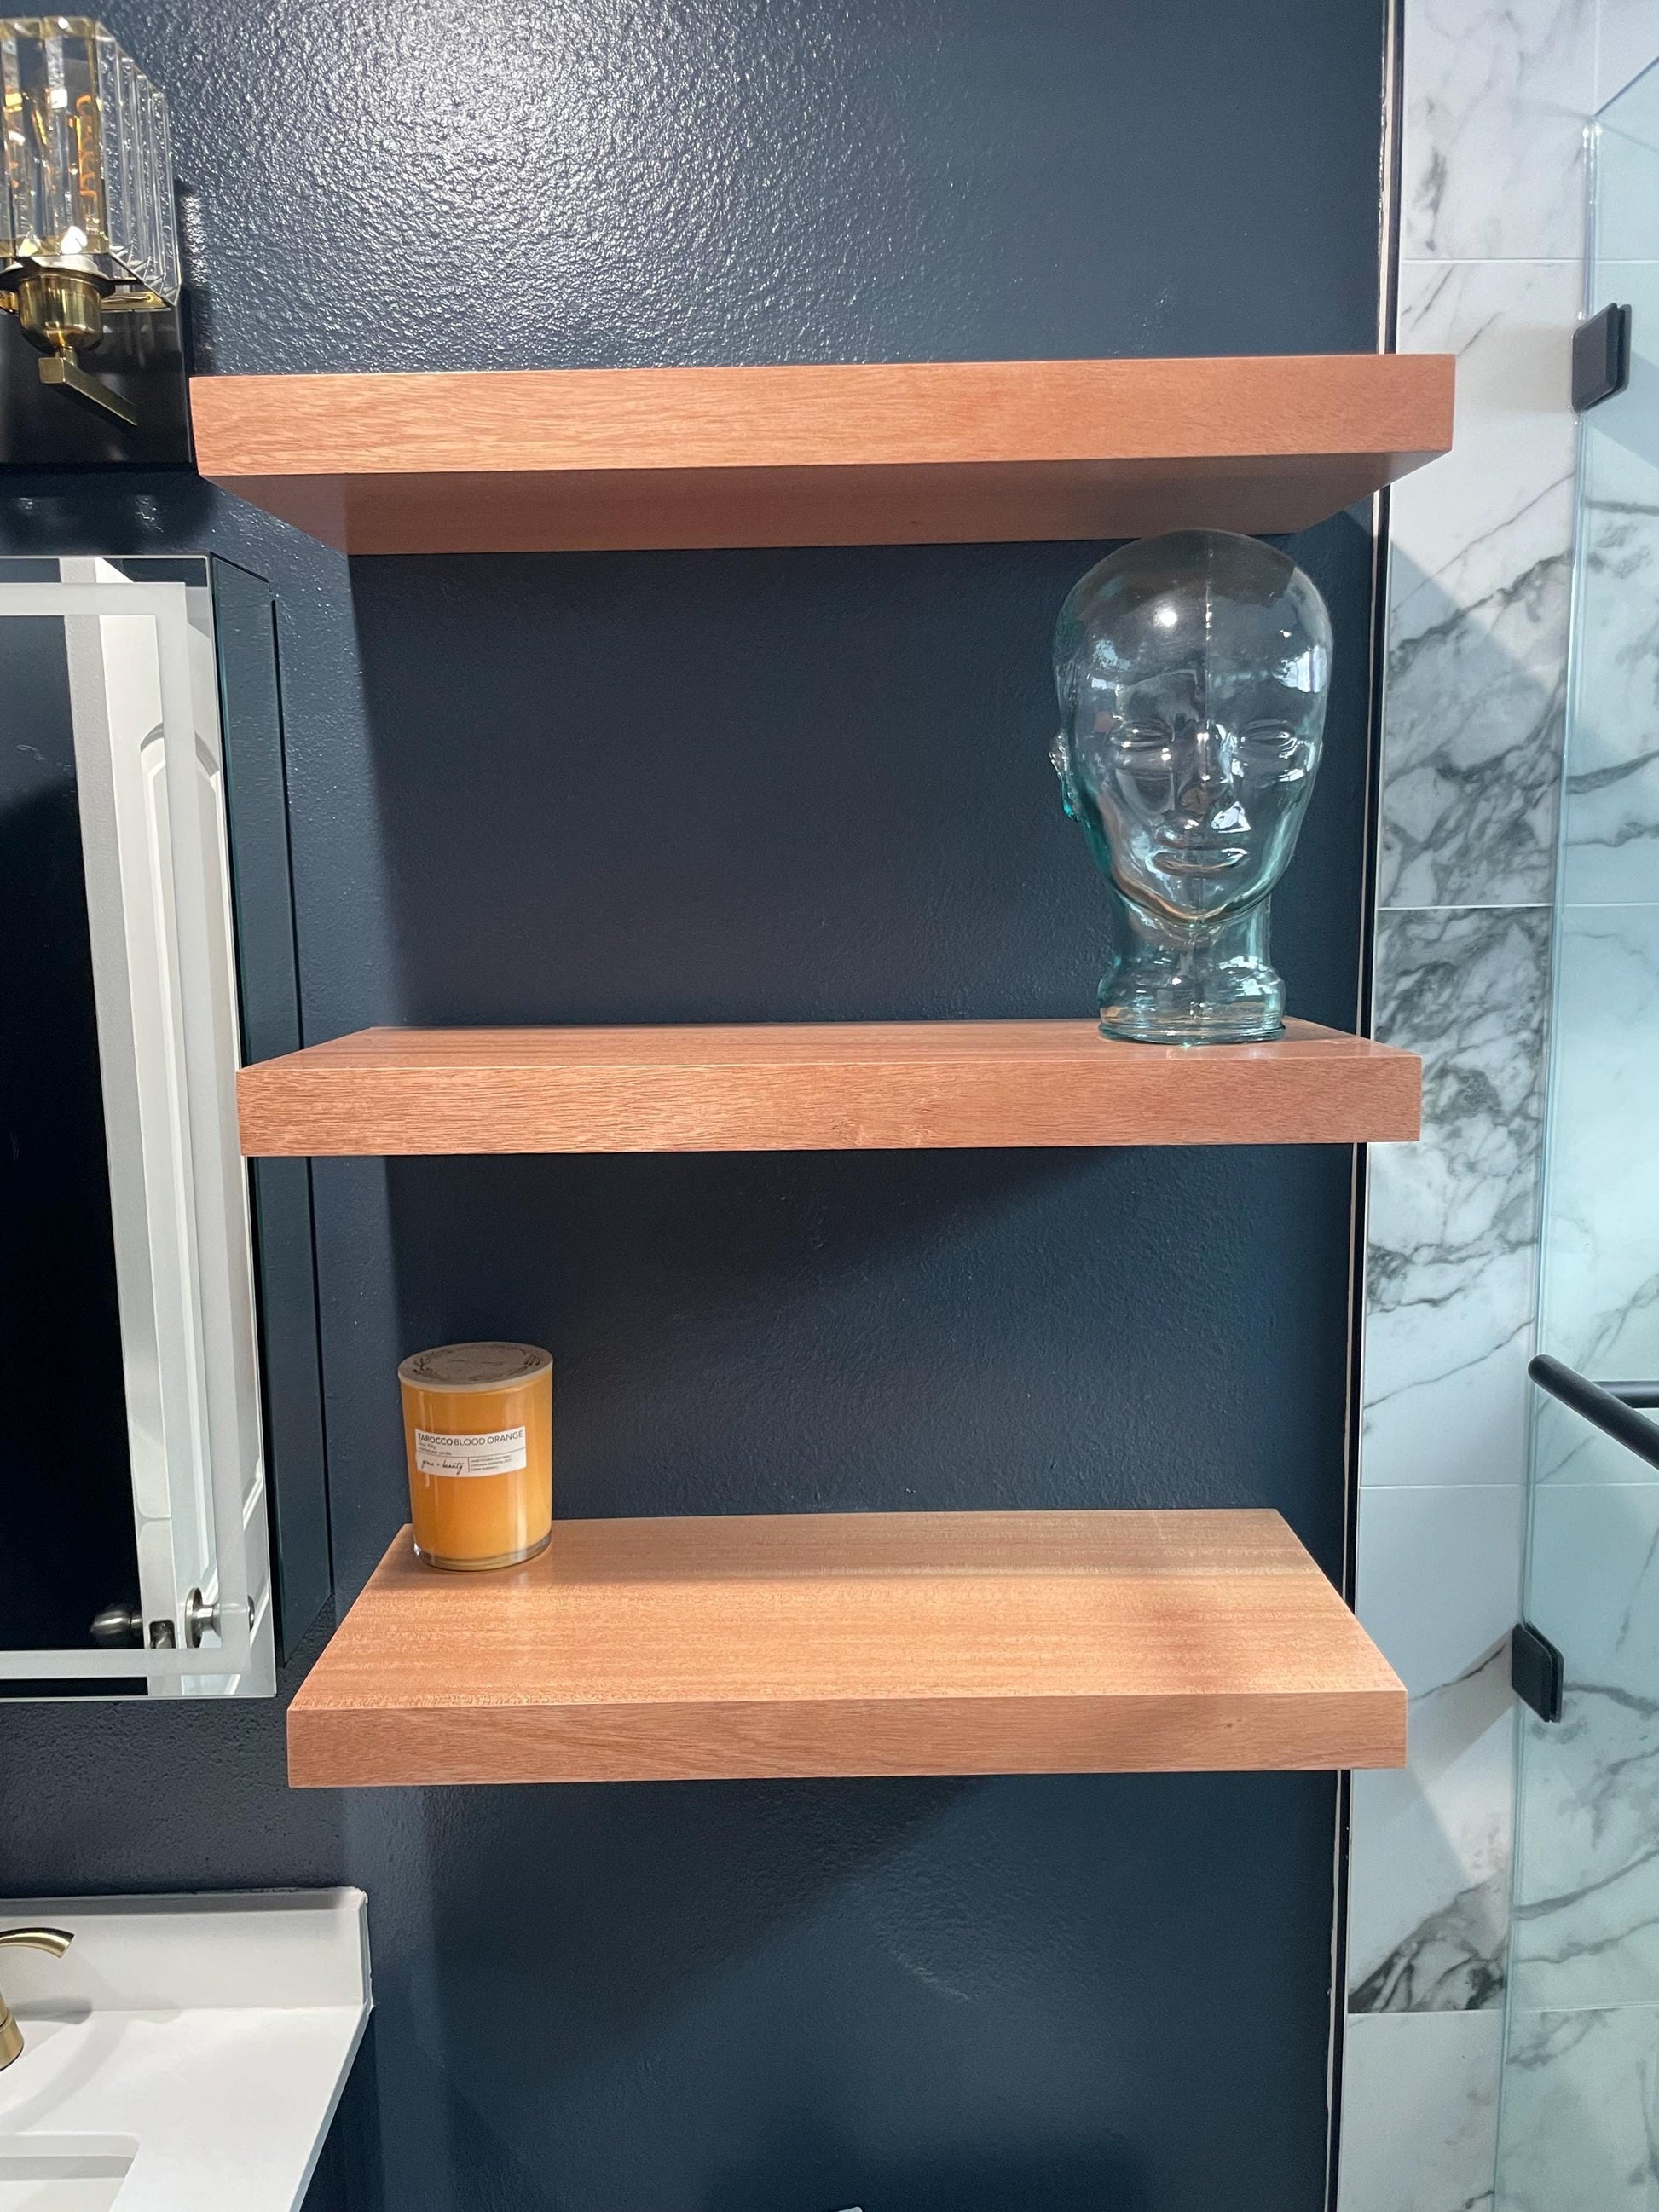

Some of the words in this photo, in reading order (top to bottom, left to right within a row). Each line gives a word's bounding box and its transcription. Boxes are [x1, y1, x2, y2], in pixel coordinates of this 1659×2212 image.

[418, 1433, 453, 1446] TAROCCO
[454, 1437, 485, 1447] BLOOD
[487, 1429, 523, 1444] ORANGE
